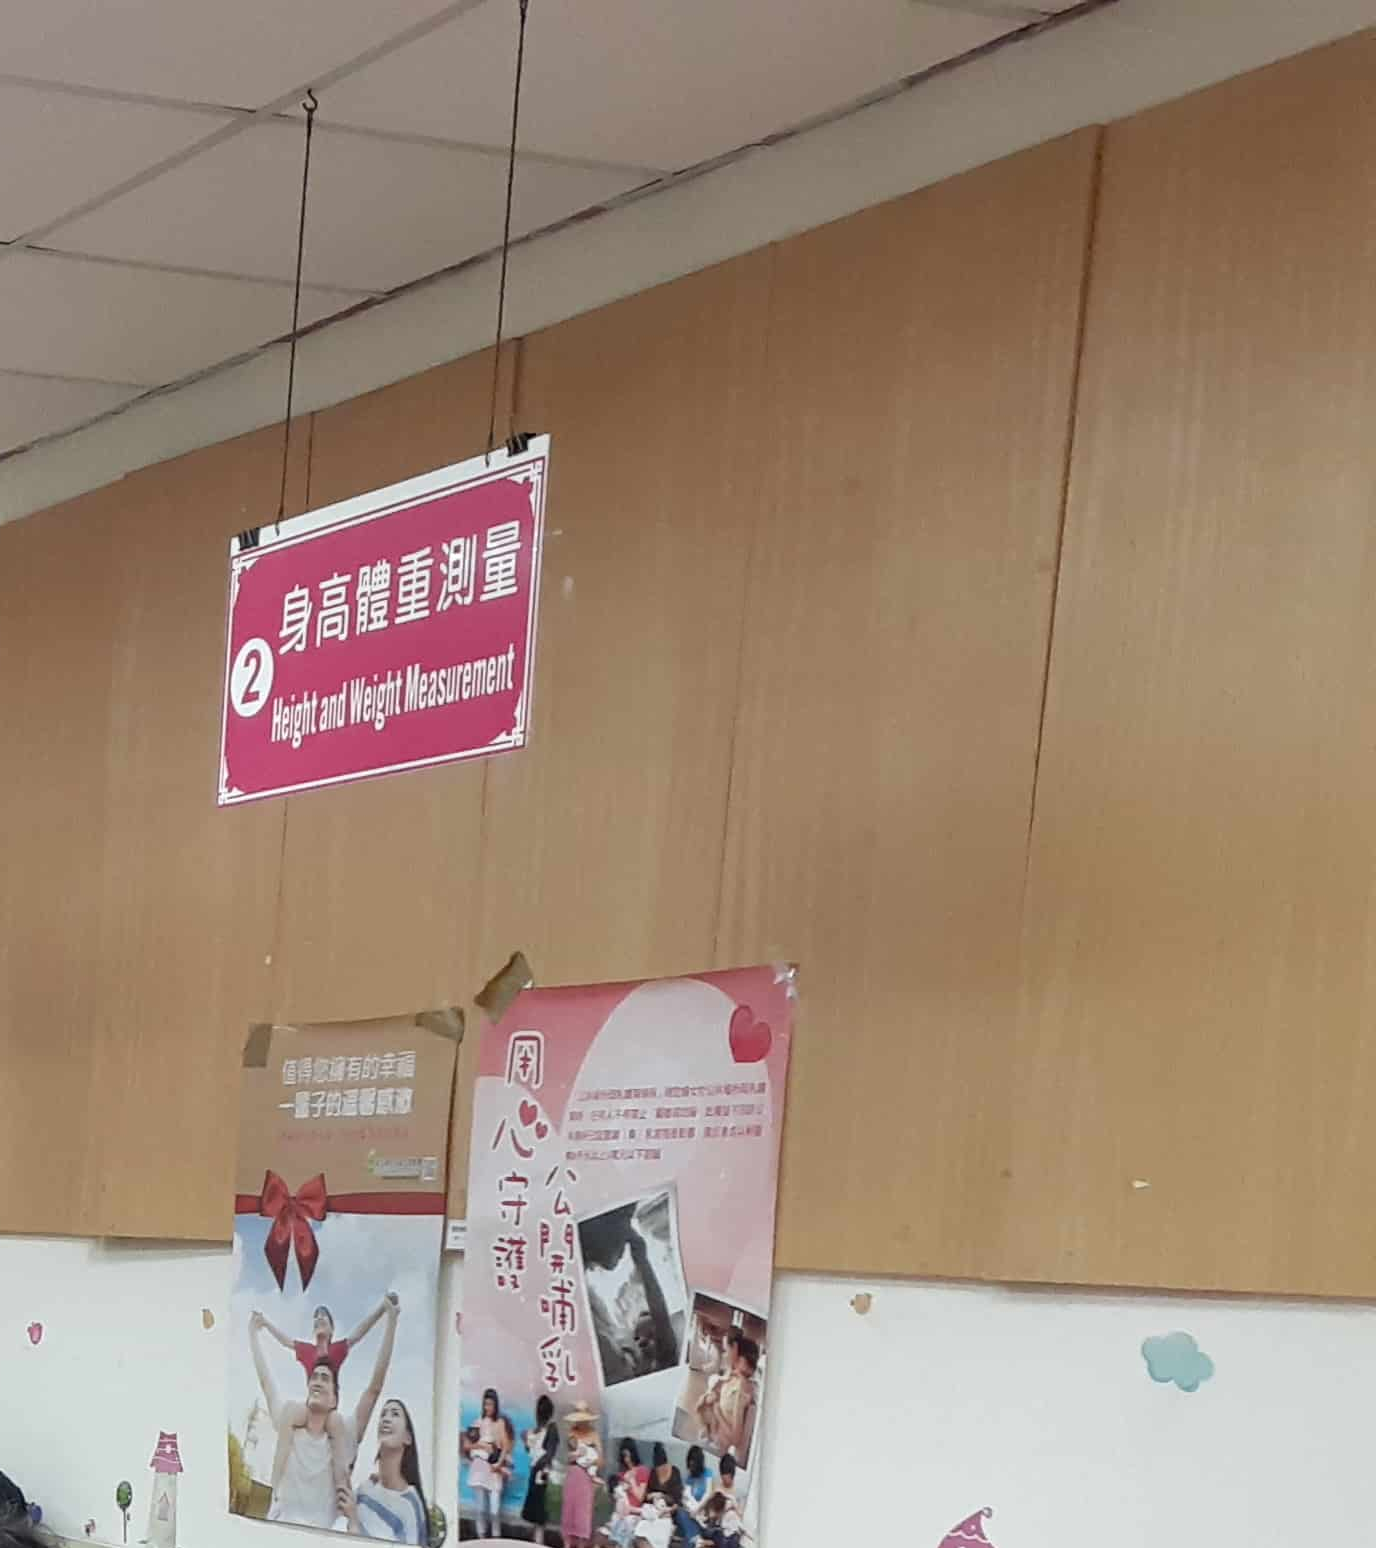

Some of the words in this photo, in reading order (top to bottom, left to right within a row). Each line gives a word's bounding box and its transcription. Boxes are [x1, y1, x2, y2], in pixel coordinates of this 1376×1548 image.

[277, 519, 522, 655] 身高體重測量
[271, 694, 318, 748] Height
[319, 688, 347, 732] and
[349, 671, 403, 731] Weight
[404, 642, 517, 713] Measurement
